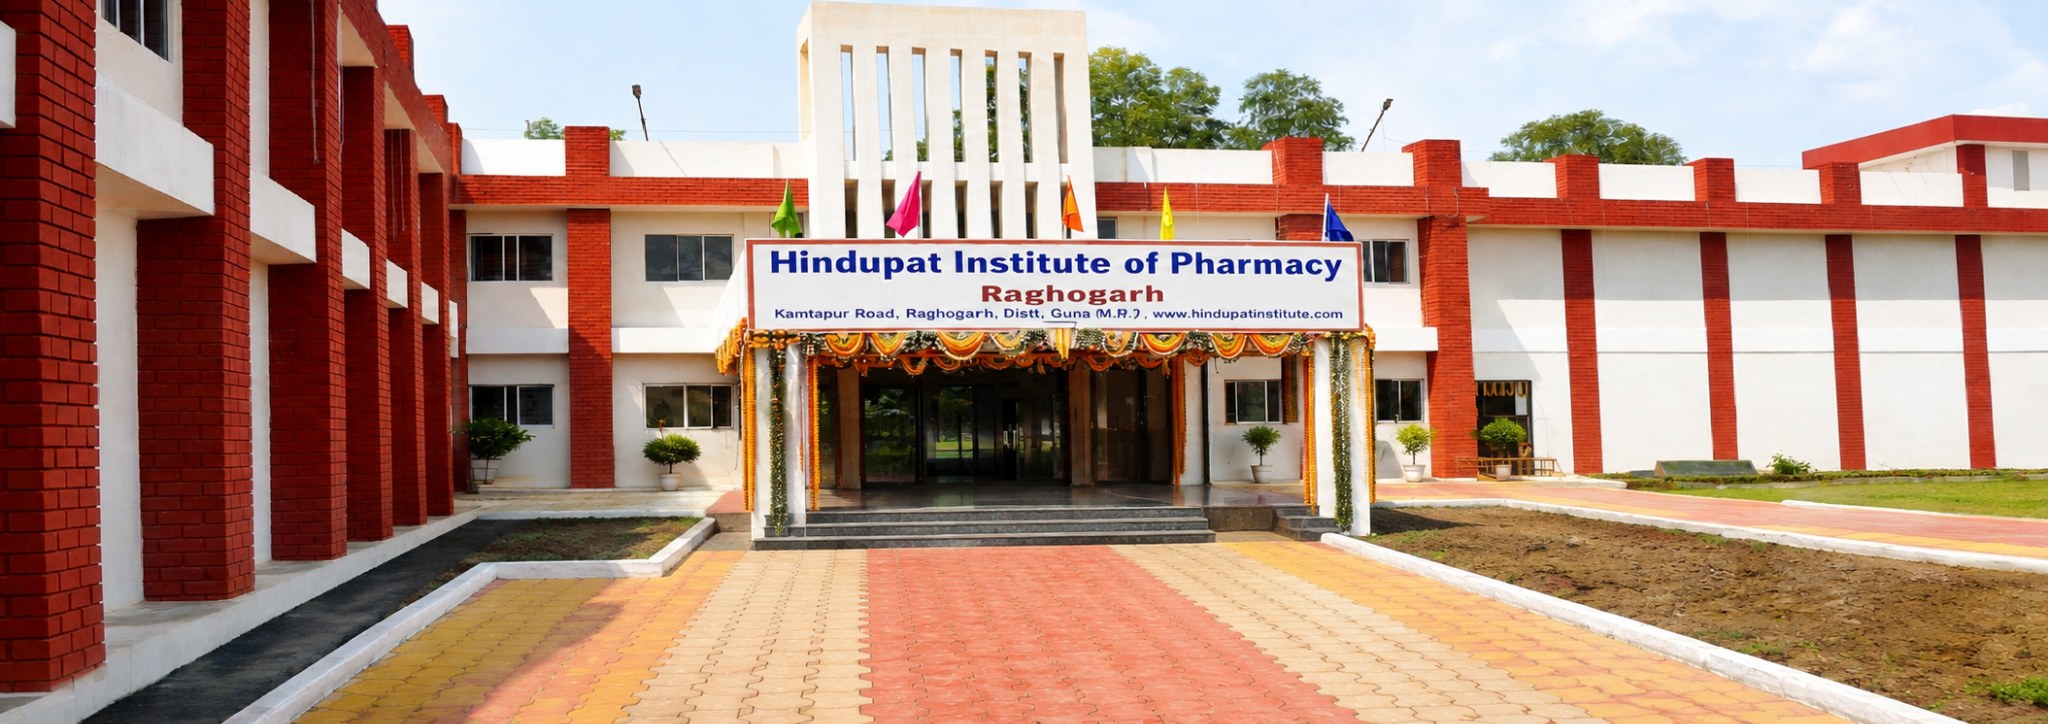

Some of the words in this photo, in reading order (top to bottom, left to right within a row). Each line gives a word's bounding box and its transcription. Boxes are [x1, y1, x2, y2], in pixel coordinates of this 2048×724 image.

[770, 250, 942, 280] Hindupat
[954, 250, 1111, 275] Institute
[1124, 251, 1159, 275] of
[1170, 251, 1343, 282] Pharmacy
[981, 285, 1164, 306] Raghogarh
[774, 308, 850, 320] Kamtapur
[855, 308, 900, 320] Road,
[906, 308, 998, 321] Raghogarh,
[1050, 308, 1091, 319] Guna
[1152, 308, 1343, 321] www.hindupatinstitute.com
